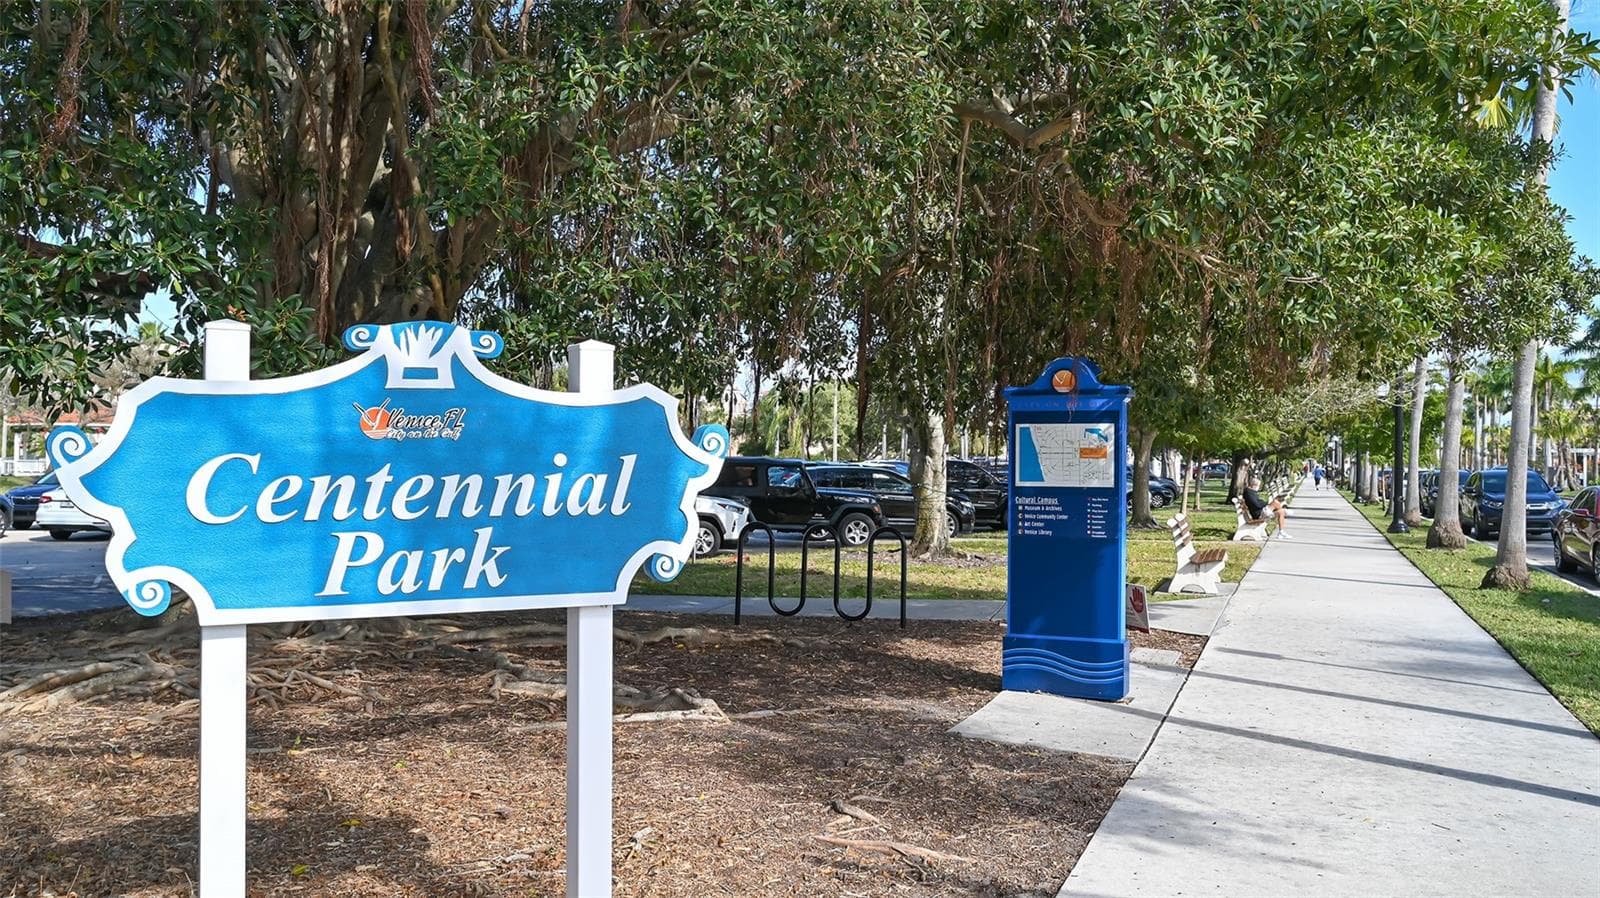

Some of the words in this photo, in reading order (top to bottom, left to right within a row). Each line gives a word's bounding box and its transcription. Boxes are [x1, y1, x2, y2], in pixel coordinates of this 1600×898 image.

[185, 453, 638, 525] Centennial
[1015, 496, 1036, 505] Cultural
[1038, 496, 1058, 505] Campus
[314, 526, 512, 596] Park
